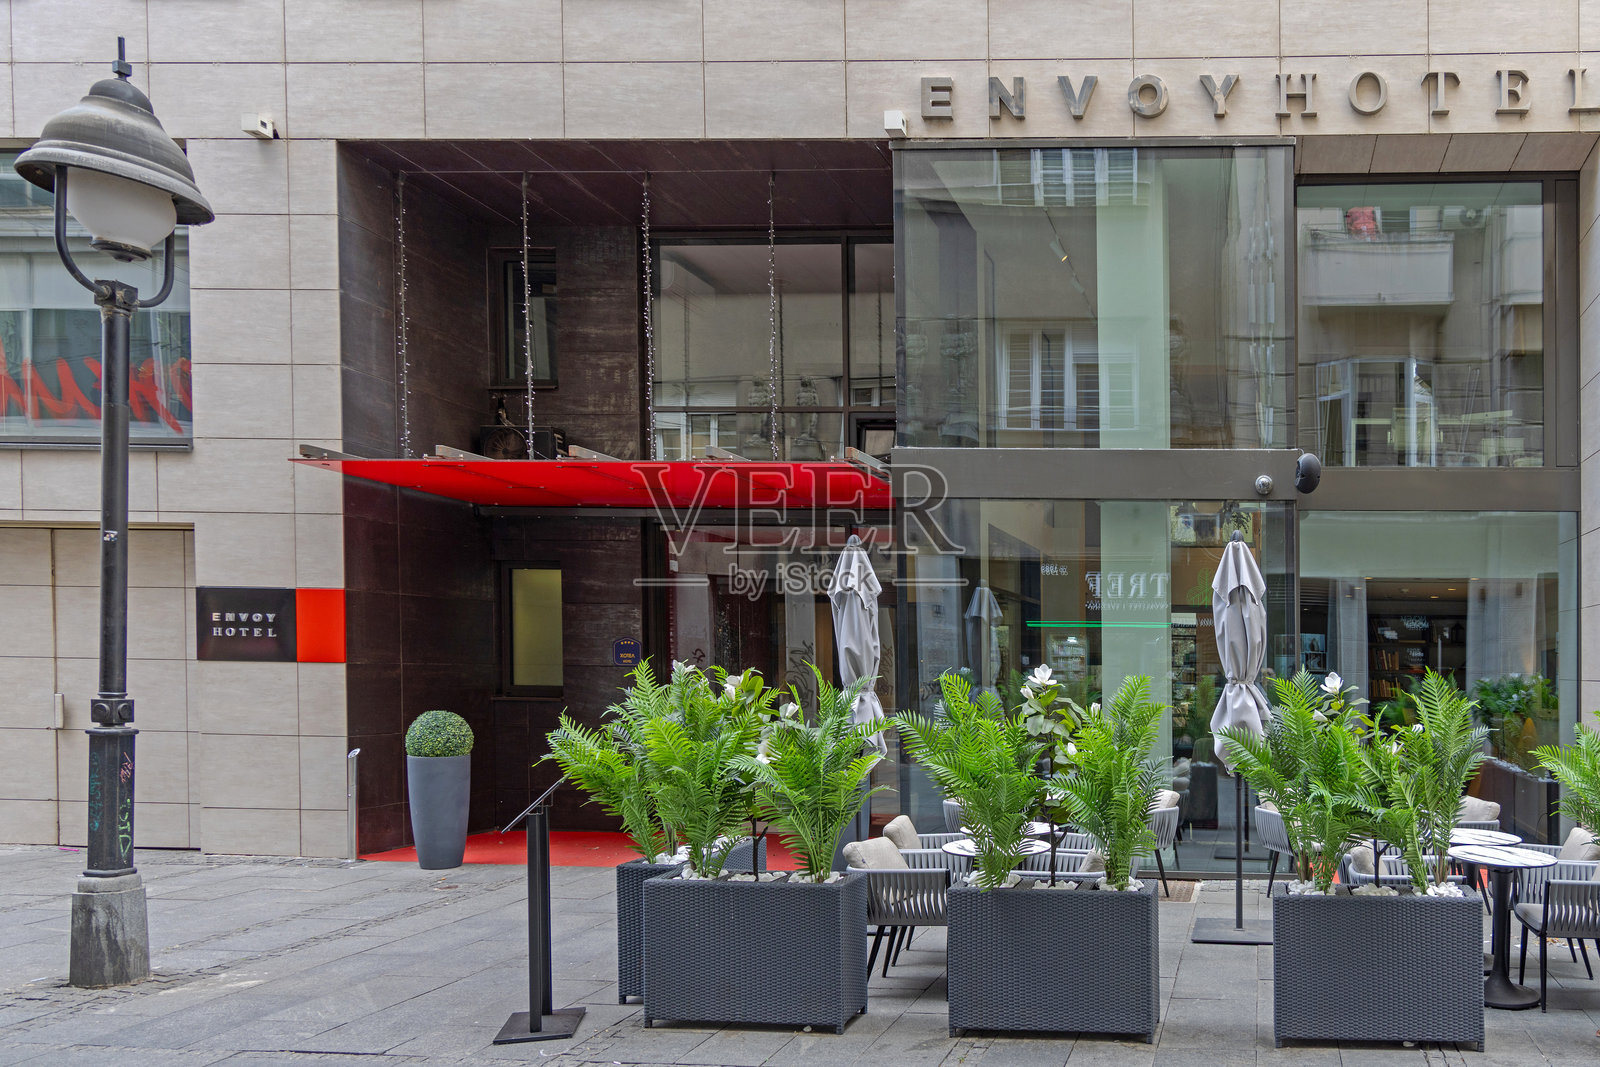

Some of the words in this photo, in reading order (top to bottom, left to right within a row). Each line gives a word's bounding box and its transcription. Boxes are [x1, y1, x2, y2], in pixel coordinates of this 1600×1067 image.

[920, 73, 1240, 121] ENVOY
[1274, 68, 1600, 119] HOTEL
[211, 612, 276, 622] ENVOY
[212, 627, 277, 637] HOTEL
